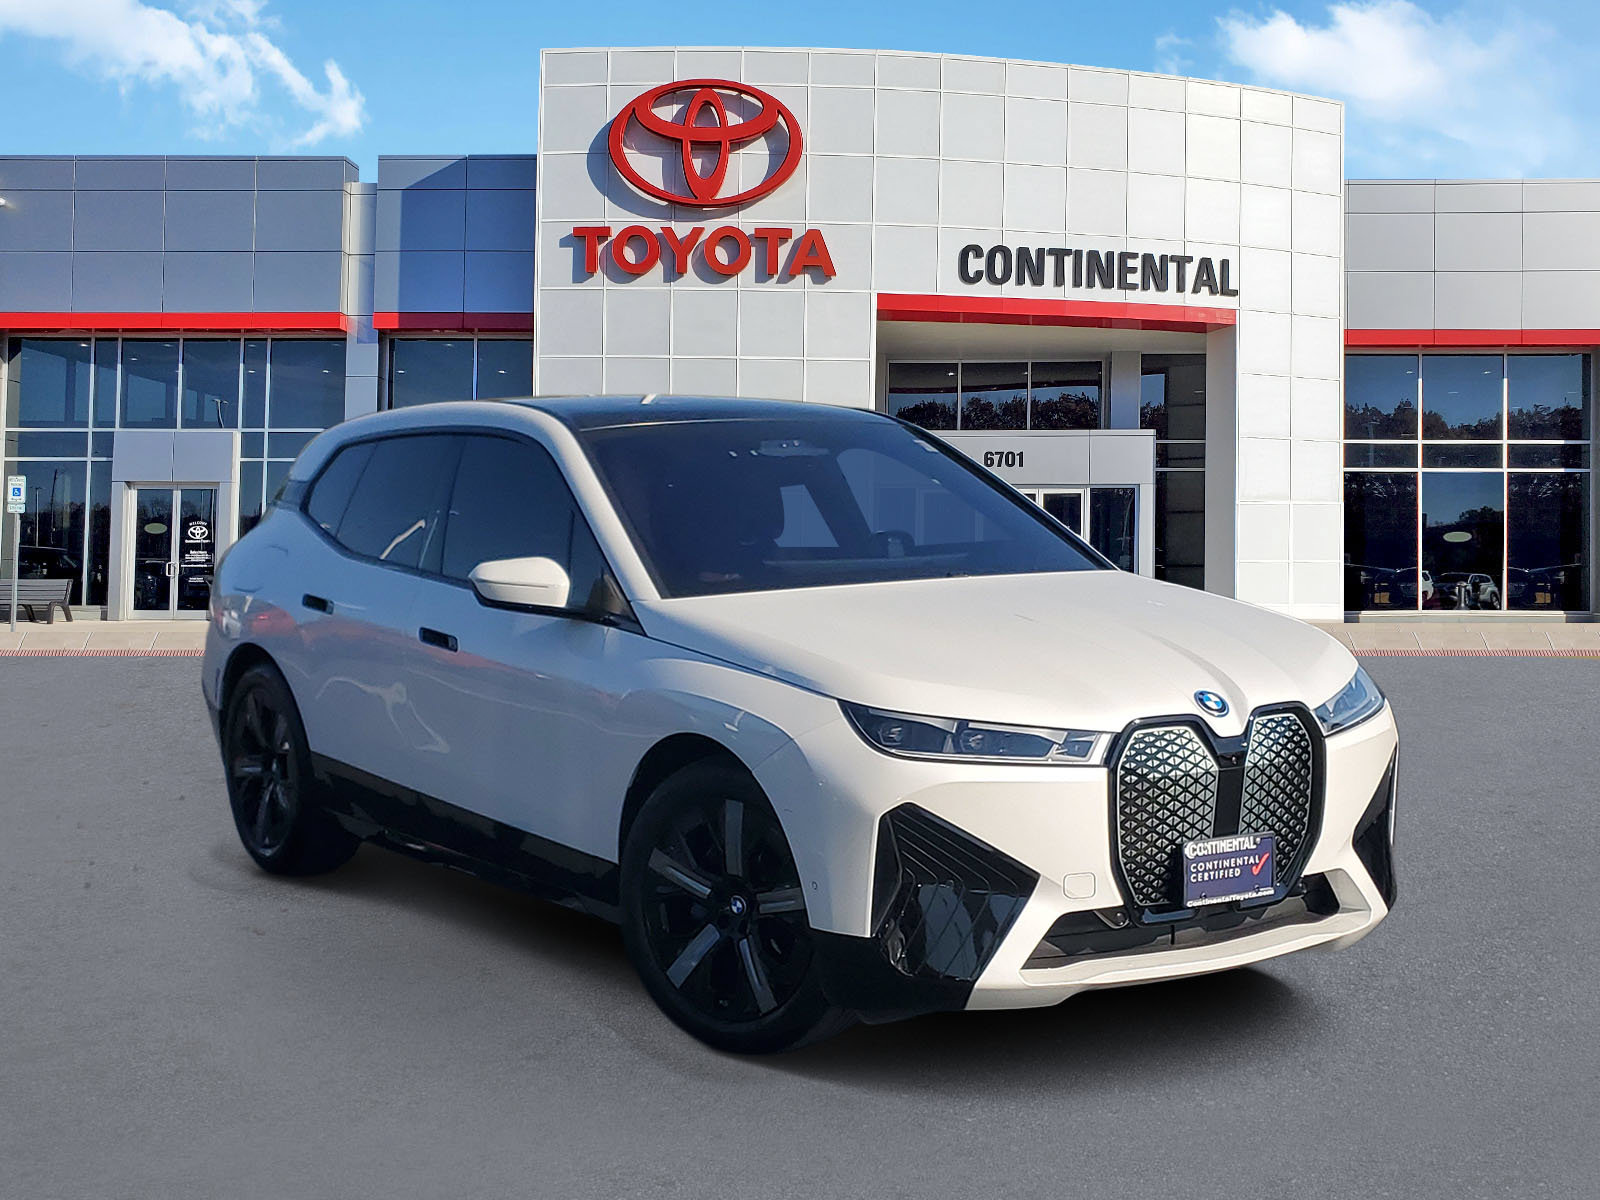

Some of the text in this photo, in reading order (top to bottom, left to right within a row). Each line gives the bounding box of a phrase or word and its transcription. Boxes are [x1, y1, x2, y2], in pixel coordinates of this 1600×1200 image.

[572, 225, 837, 277] TOYOTA
[958, 244, 1239, 296] CONTINENTAL
[983, 451, 1024, 468] 6701
[1187, 836, 1257, 858] CONTINENTAL
[1190, 855, 1259, 872] CONTINENTAL
[1190, 868, 1241, 883] CERTIFIED
